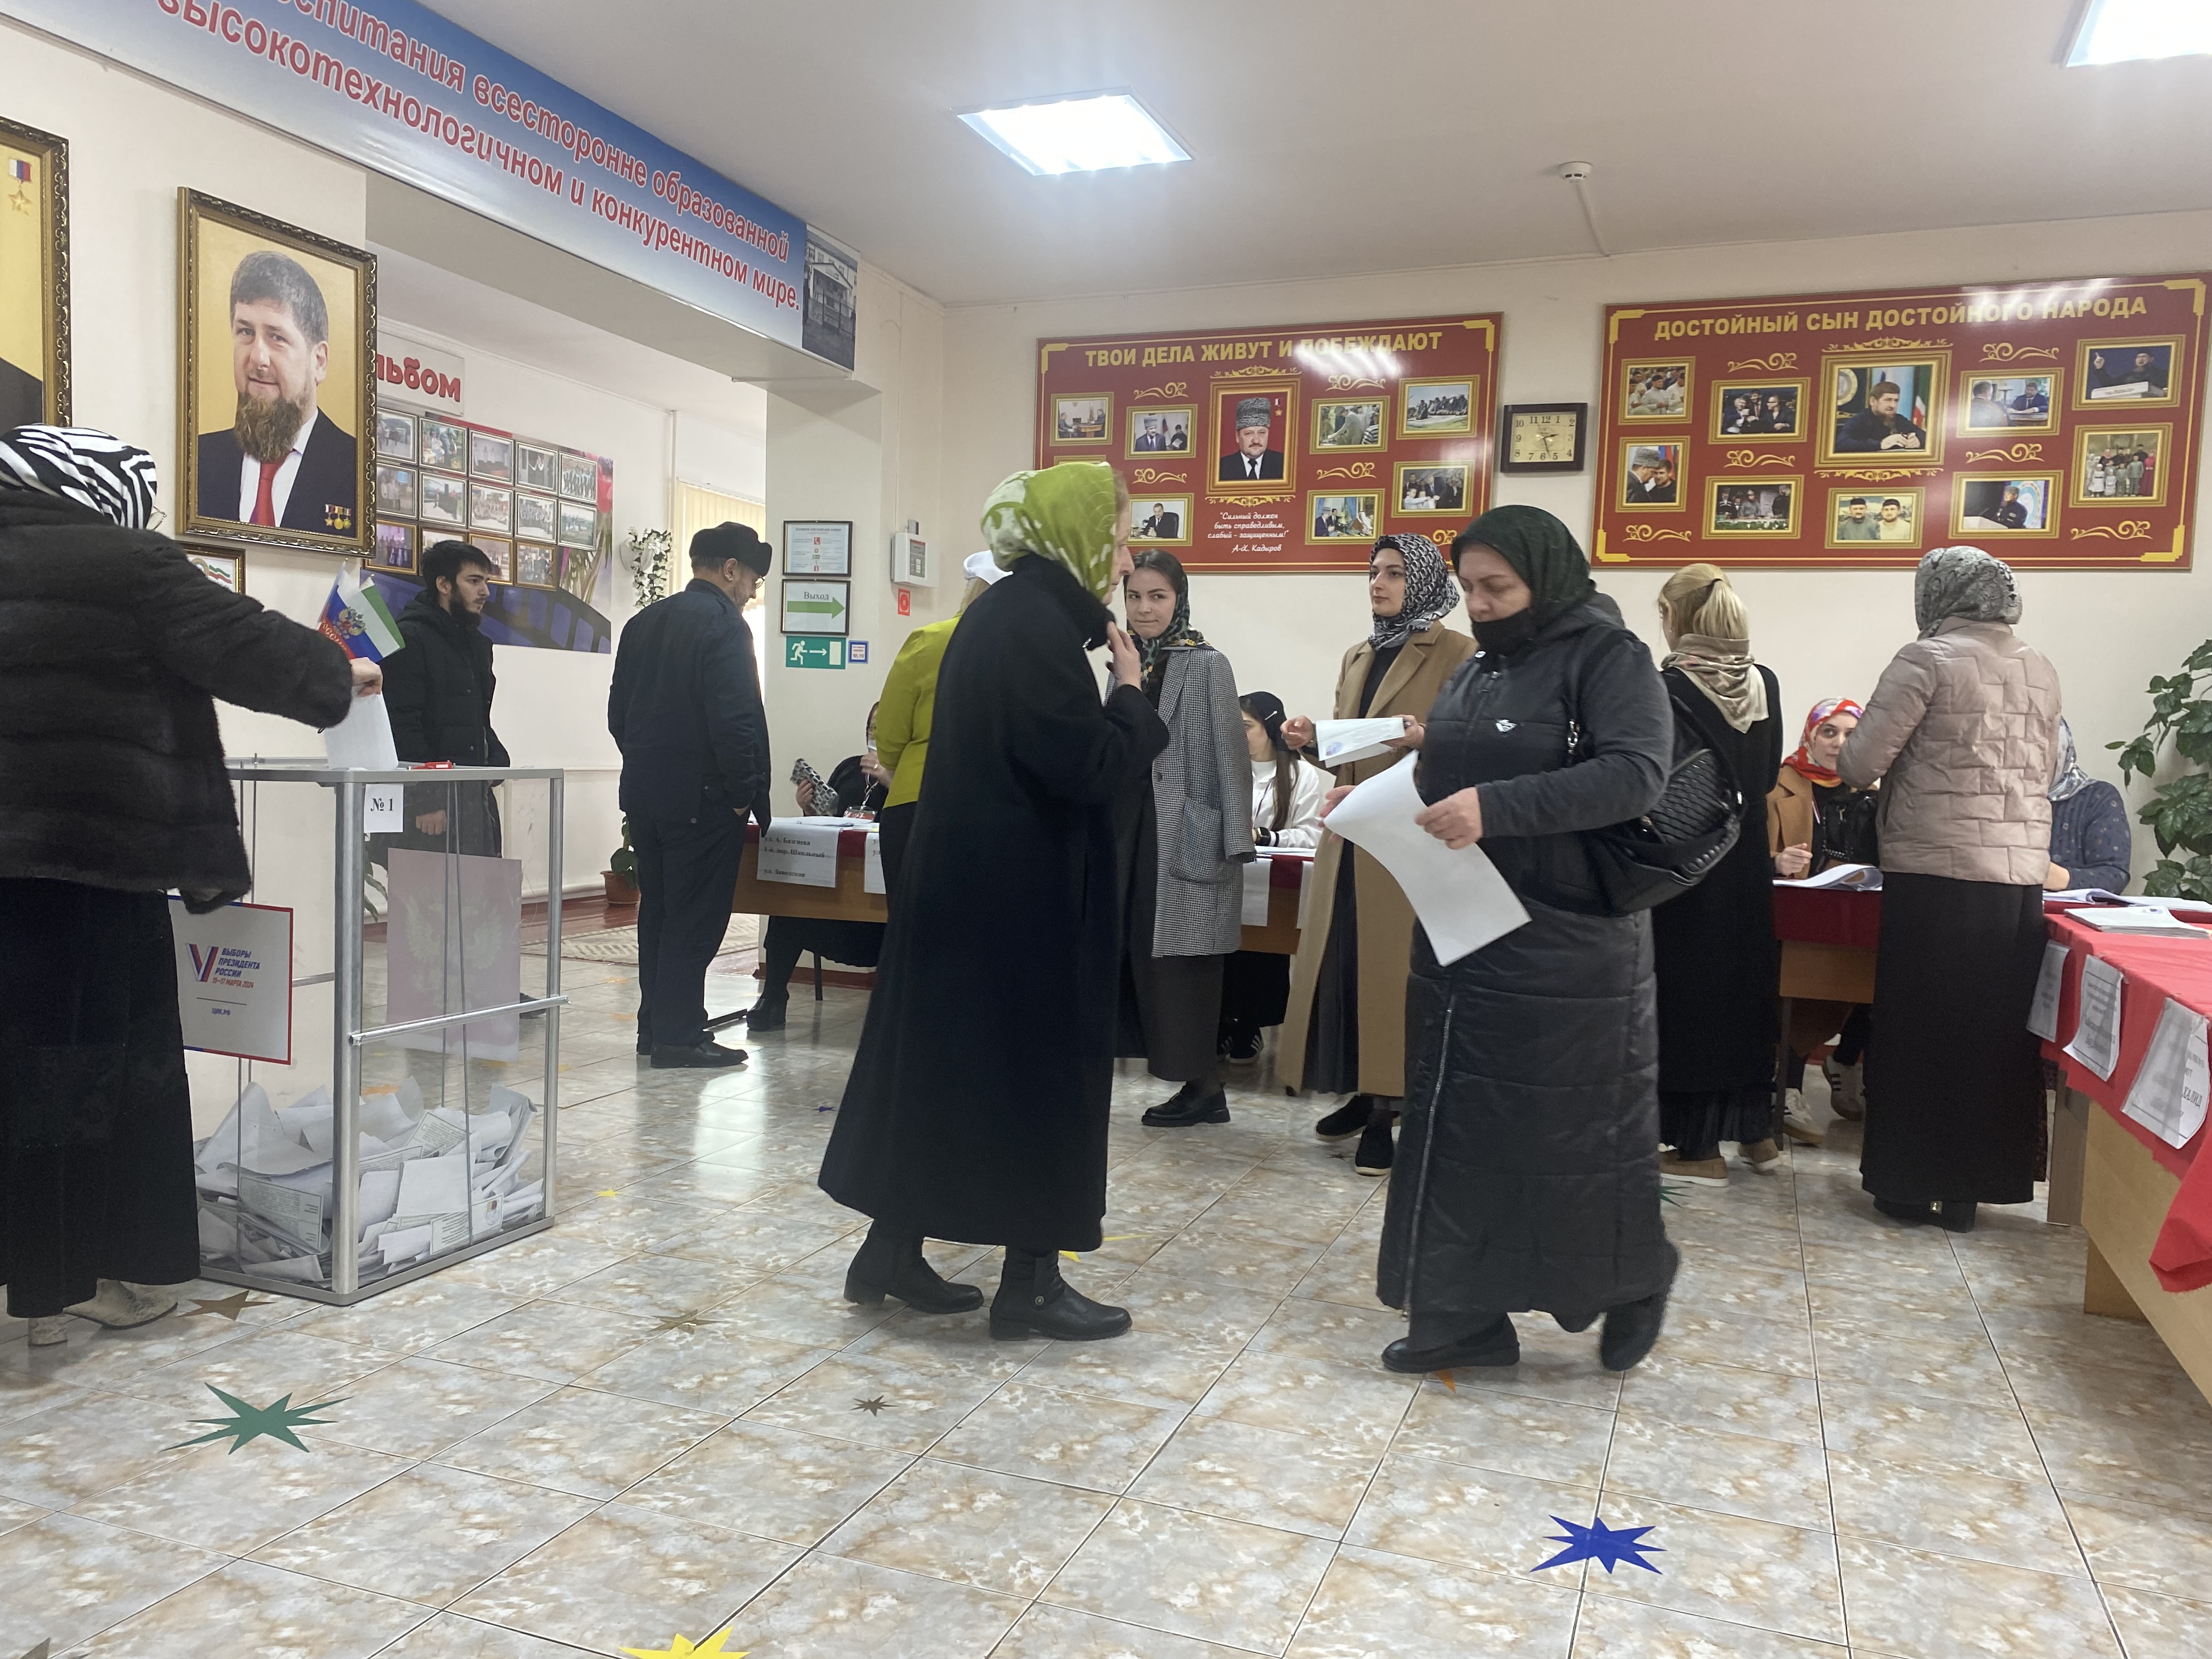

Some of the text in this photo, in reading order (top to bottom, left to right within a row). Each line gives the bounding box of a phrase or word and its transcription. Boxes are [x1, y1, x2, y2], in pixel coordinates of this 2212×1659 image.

[279, 0, 789, 263] питания всесторонне образованной
[571, 178, 584, 206] и
[592, 188, 748, 285] конкурентном
[753, 268, 799, 310] мире.
[1654, 297, 2147, 341] ДОСТОЙНЫЙ СЫН ДОСТОЙНОГО НАРОДА
[1085, 332, 1442, 367] ТВОИ ДЕЛА ЖИВУТ И ПОБЕЖДАЮТ
[1251, 544, 1282, 553] Кадыров
[804, 591, 829, 600] Выход
[371, 798, 393, 811] № 1
[222, 947, 252, 958] ВЫБОРЫ
[218, 957, 260, 970] ПРЕЗИДЕНТА
[215, 967, 242, 978] РОССИИ
[225, 978, 242, 987] МАРТА
